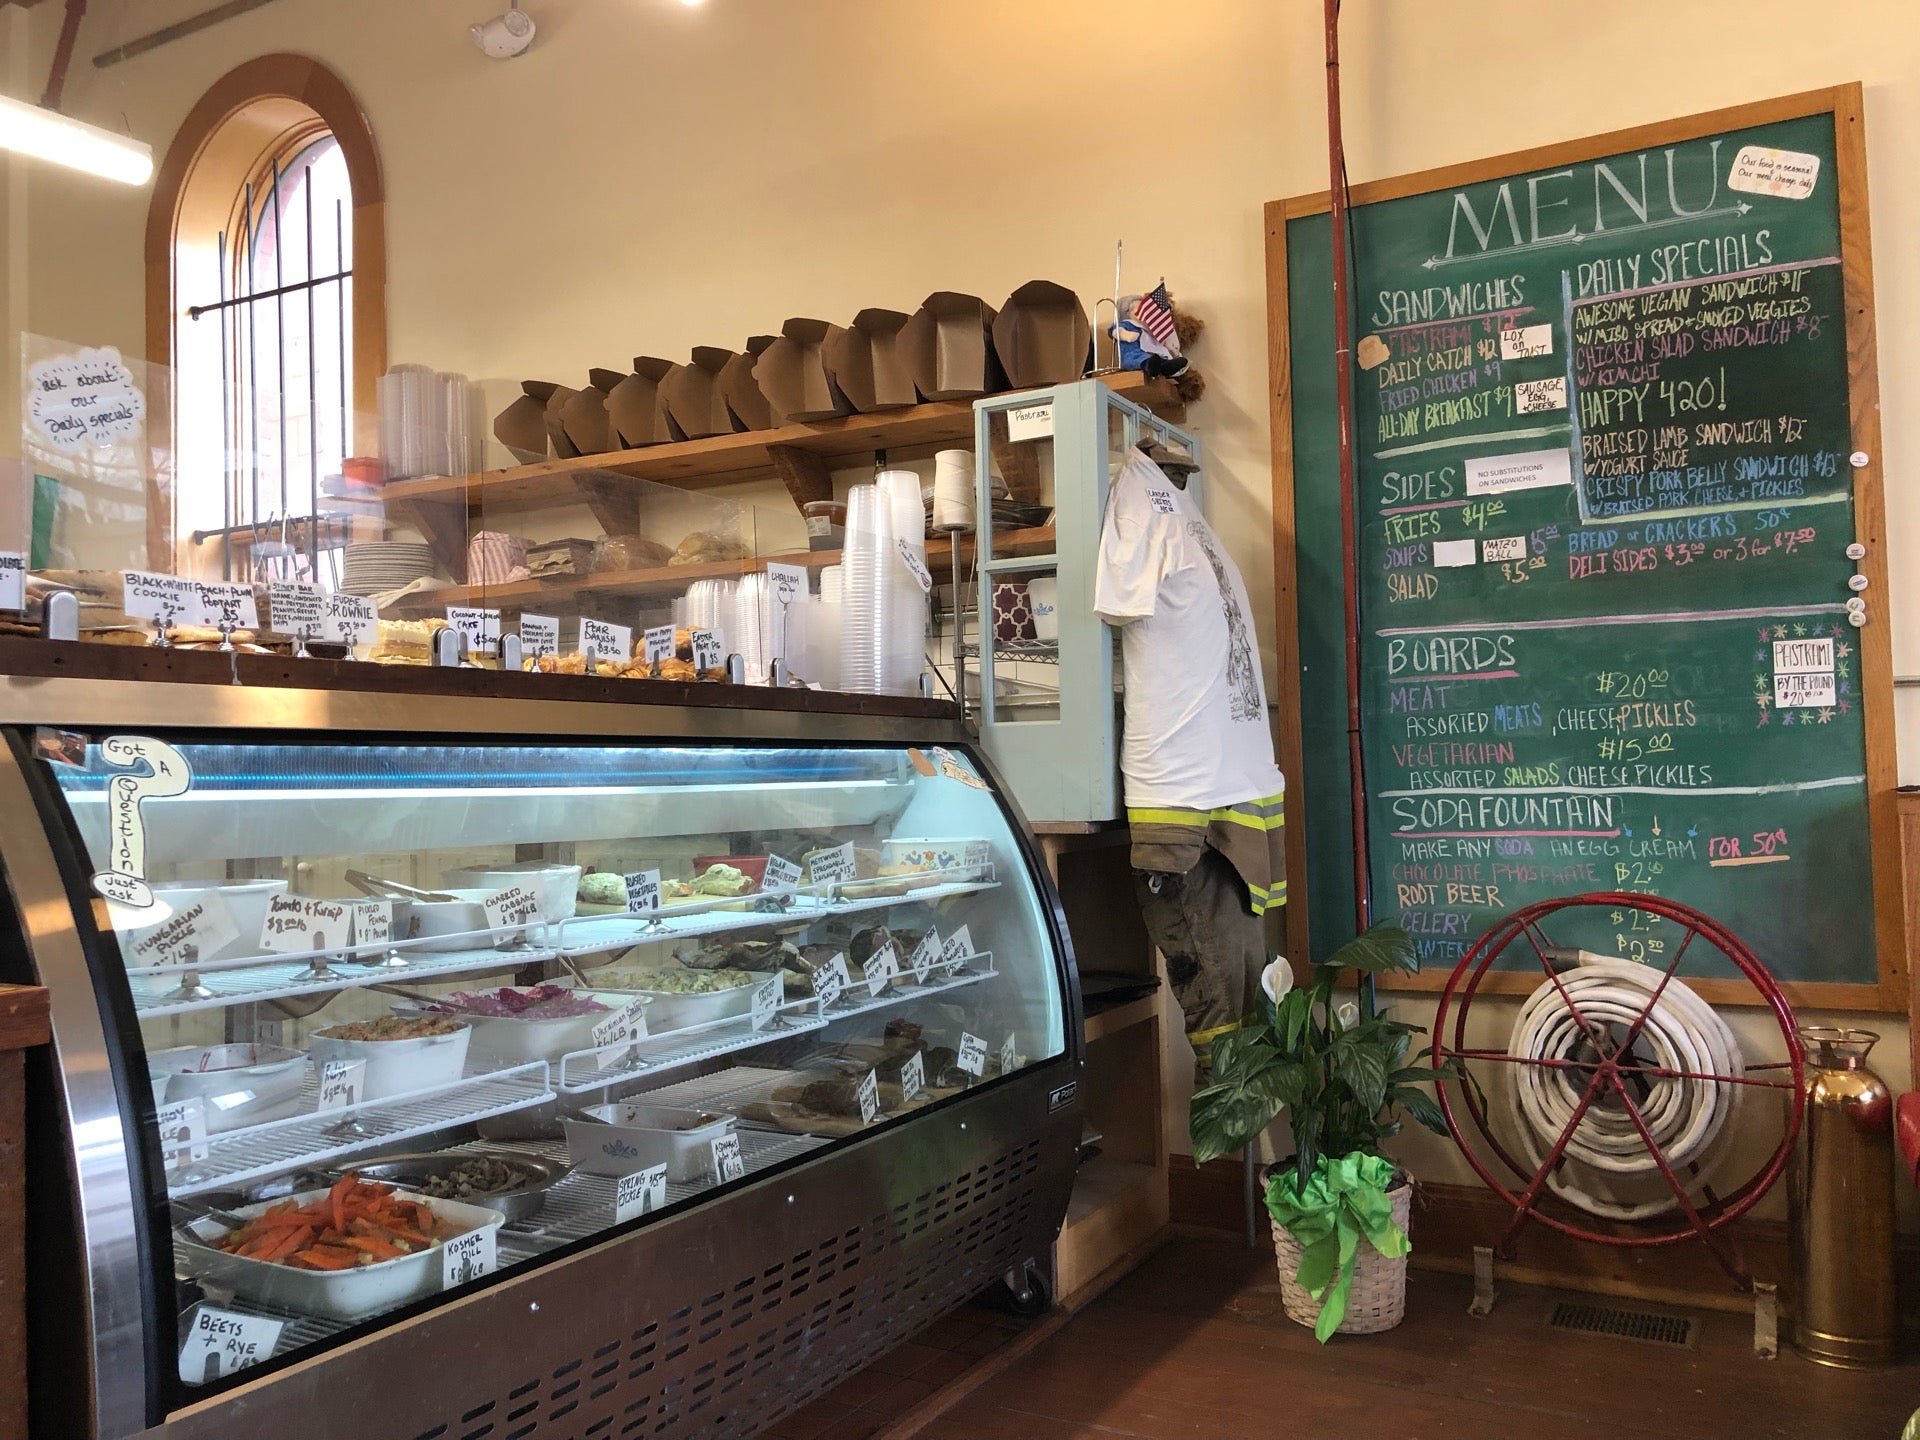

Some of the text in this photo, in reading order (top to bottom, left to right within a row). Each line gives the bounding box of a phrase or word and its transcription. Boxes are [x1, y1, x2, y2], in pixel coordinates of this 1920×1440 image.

[1444, 139, 1724, 258] MENU
[1578, 229, 1773, 296] DAILY SPECIALS
[1371, 274, 1525, 326] SANDWICHES
[1575, 273, 1777, 330] AWESOME VEGAN SANDWICH
[1634, 316, 1684, 338] SPREAD
[1695, 306, 1744, 331] SMOKED
[1748, 296, 1811, 321] VEGGIES
[1504, 329, 1525, 341] LOX
[1512, 341, 1524, 350] on
[1575, 321, 1791, 371] CHICKEN SALAD SANDWICH
[1379, 357, 1422, 389] DAILY
[1426, 345, 1472, 371] CATCH
[1598, 362, 1661, 386] KIMCHI
[42, 370, 118, 392] ask about
[1379, 387, 1420, 414] FRIED
[1422, 370, 1477, 396] CHICKEN
[71, 395, 98, 407] our
[1425, 390, 1491, 432] BREAKFAST
[1494, 385, 1512, 418] $9
[1580, 366, 1727, 429] HAPPY 420!
[89, 403, 134, 428] specials
[1015, 409, 1049, 422] Pastrami
[1583, 418, 1772, 458] BRAISED LAMB SANDWICH
[1477, 463, 1544, 479] NO SUBSTITUTIONS
[1652, 449, 1689, 471] SAUCE
[1380, 466, 1456, 505] SIDES
[1478, 474, 1537, 488] ON SANDWICHES
[1586, 452, 1809, 499] CRISPY PORK BELLY SANDWICH
[1751, 479, 1804, 499] PICKLES
[1384, 510, 1441, 545] FRIES
[1568, 530, 1619, 554] BREAD
[1644, 513, 1738, 545] CRACKERS
[1383, 543, 1428, 570] SOUPS
[1487, 551, 1513, 562] BALL
[1569, 551, 1609, 580] DELI
[1612, 547, 1658, 572] SIDES
[1734, 537, 1748, 561] 3
[771, 572, 800, 585] CHALLAH
[1387, 573, 1439, 603] SALAD
[133, 588, 181, 602] COOKIE
[202, 597, 242, 610] POPTART
[333, 595, 361, 606] FUDGE
[223, 608, 239, 621] $5
[457, 620, 479, 630] CAKE
[584, 631, 616, 644] DANISH
[585, 620, 609, 635] PEAR
[692, 631, 713, 643] EASTER
[597, 642, 621, 655] $3.50
[709, 653, 719, 665] $5
[1388, 634, 1516, 675] BOARDS
[1775, 642, 1832, 668] PASTRAMI
[1776, 675, 1834, 690] BY THE POUND
[1389, 685, 1451, 714] MEAT
[1406, 701, 1543, 738] ASSORTED MEATS
[107, 738, 146, 756] Got
[1392, 741, 1515, 768] VEGETARIAN
[160, 760, 172, 777] A
[1410, 769, 1496, 790] ASSORTED
[1635, 764, 1713, 786] PICKLES
[1393, 796, 1613, 832] SODA FOUNTAIN
[1402, 839, 1452, 862] MAKE
[1457, 838, 1491, 860] ANY
[1495, 839, 1534, 856] SODA
[1551, 840, 1573, 858] AN
[1578, 841, 1620, 857] EGG
[1629, 839, 1697, 860] CREAM
[1709, 836, 1741, 858] FOR
[1393, 862, 1485, 882] CHOCOLATE
[108, 889, 135, 901] ask
[485, 887, 521, 908] CHARRED
[500, 890, 536, 913] CABBAGE
[1397, 883, 1504, 909] ROOT BEER
[313, 902, 343, 921] Turnip
[357, 903, 380, 916] PICKLED
[136, 903, 204, 955] HUNGARIAN
[1400, 910, 1472, 934] CELERY
[156, 924, 196, 955] PICKLE
[618, 1173, 646, 1193] SPRING
[447, 1234, 483, 1256] KOSHER
[461, 1247, 482, 1260] DILL
[200, 1313, 243, 1336] BEETS
[226, 1340, 258, 1355] RYE
